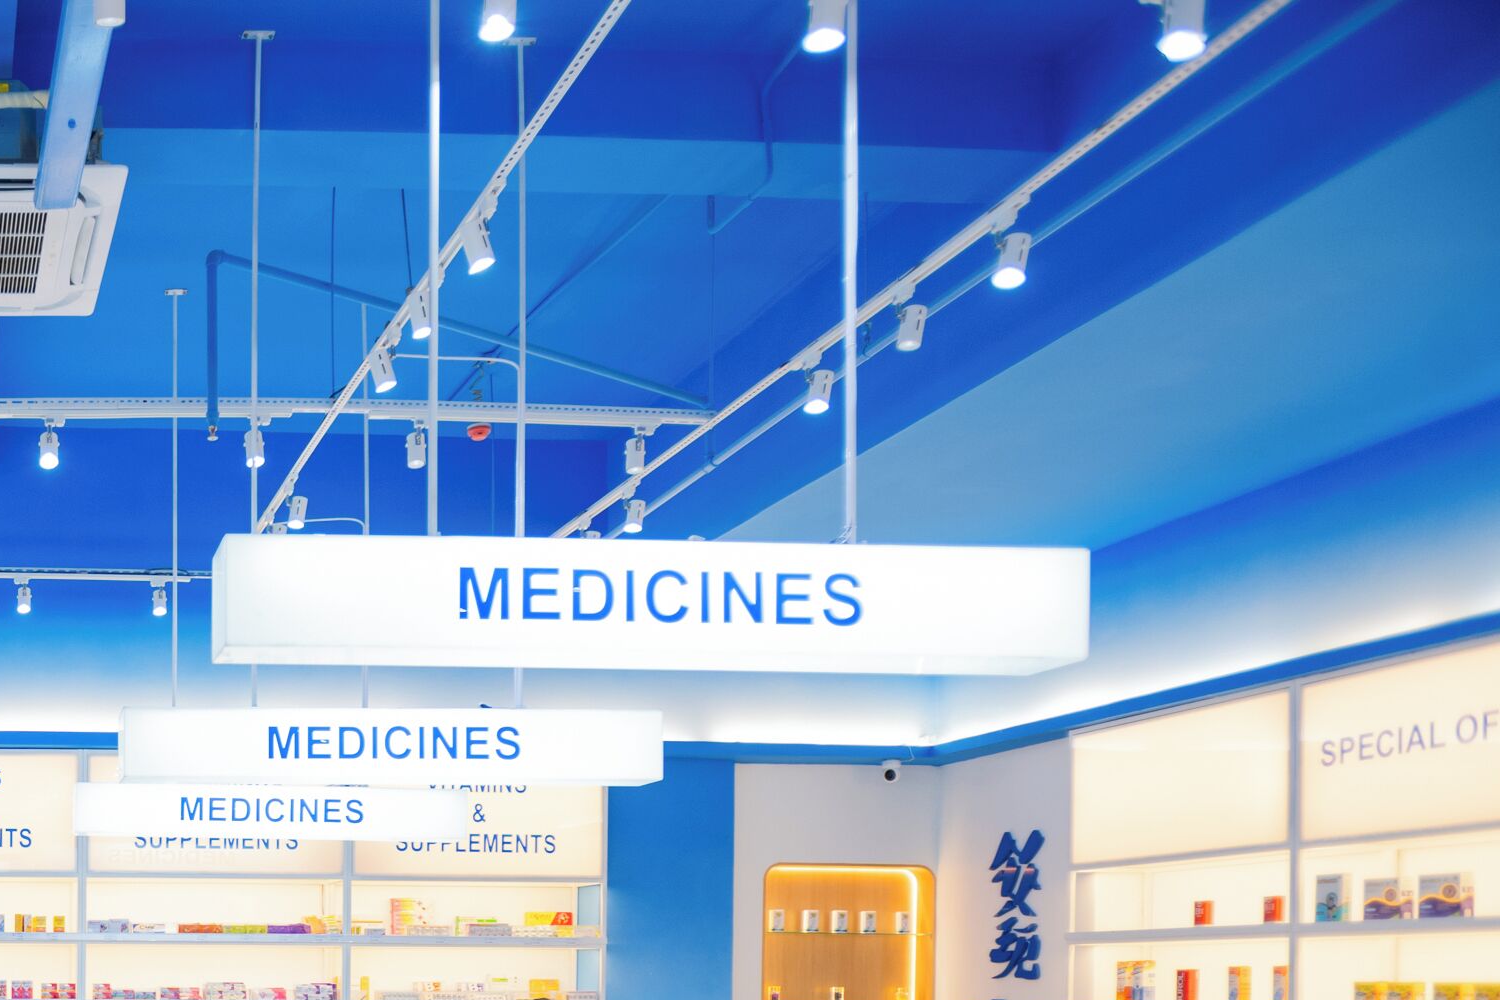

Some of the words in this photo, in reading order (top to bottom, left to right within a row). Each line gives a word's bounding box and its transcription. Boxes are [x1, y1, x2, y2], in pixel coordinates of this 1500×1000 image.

[459, 566, 862, 627] MEDICINES
[268, 725, 521, 760] MEDICINES
[1321, 721, 1445, 767] SPECIAL
[180, 796, 365, 824] MEDICINES
[472, 803, 486, 823] &
